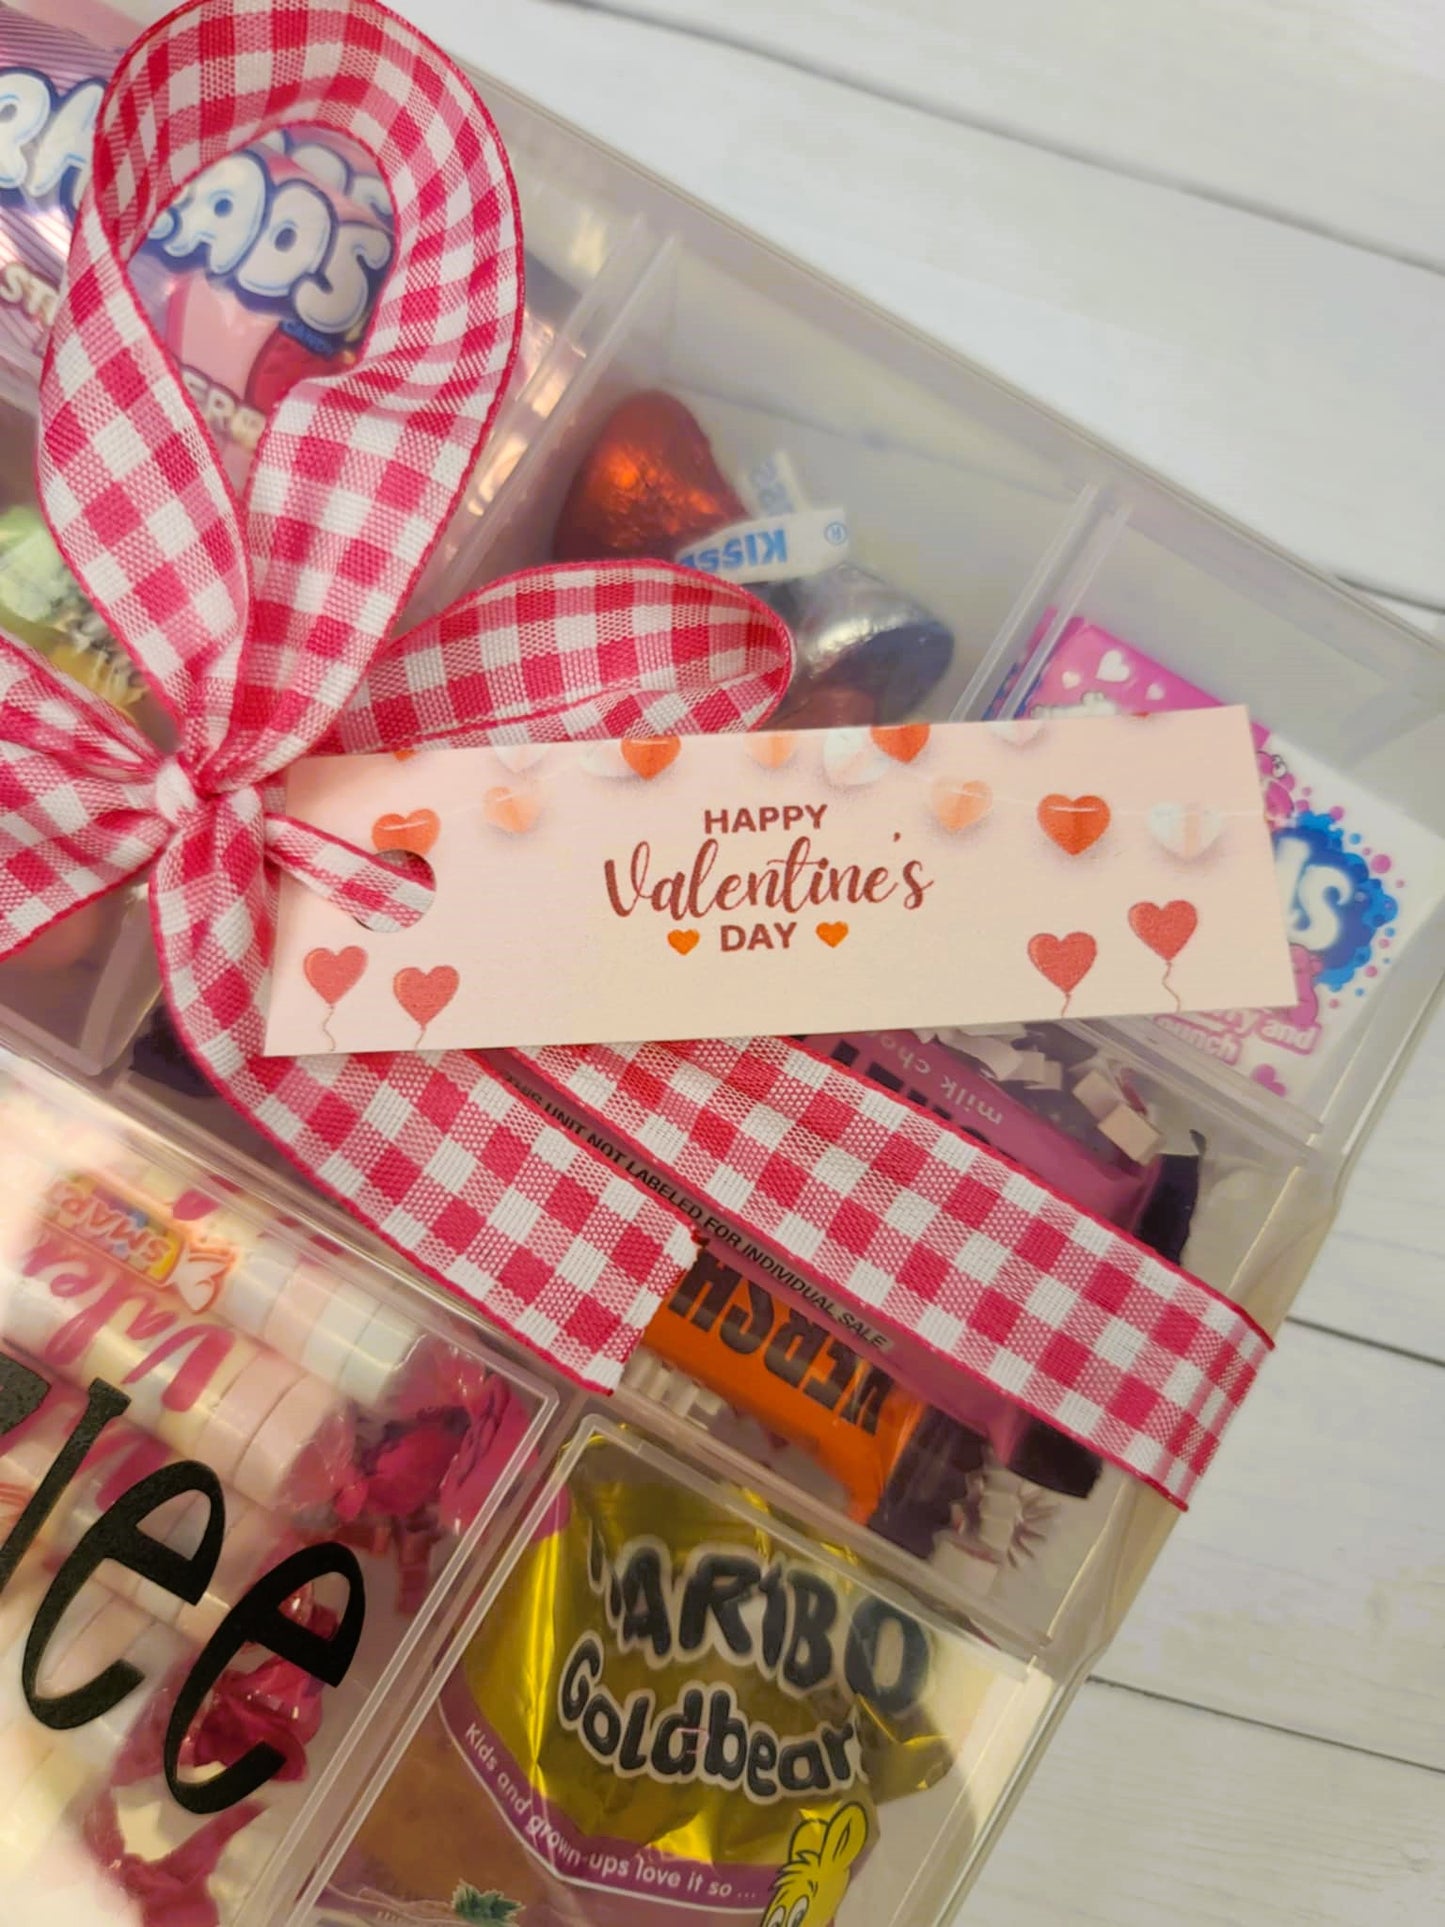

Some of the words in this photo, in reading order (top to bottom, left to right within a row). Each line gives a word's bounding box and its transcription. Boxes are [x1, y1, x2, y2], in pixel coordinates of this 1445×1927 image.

[703, 803, 829, 835] HAPPY
[603, 831, 935, 922] Valentine's
[719, 921, 798, 952] DAY
[940, 1075, 1005, 1125] milk
[543, 1102, 588, 1136] UNIT
[586, 1132, 628, 1164] NOT
[624, 1159, 703, 1220] LABELED
[703, 1215, 743, 1249] FOR
[742, 1242, 834, 1318] INDIVIDUAL
[835, 1311, 889, 1349] SALE
[561, 1642, 857, 1797] Goldbear
[465, 1722, 499, 1772] Kids
[497, 1771, 533, 1815] and
[524, 1815, 631, 1879] grown-ups
[635, 1854, 682, 1888] love
[686, 1870, 704, 1893] it
[707, 1880, 733, 1899] so
